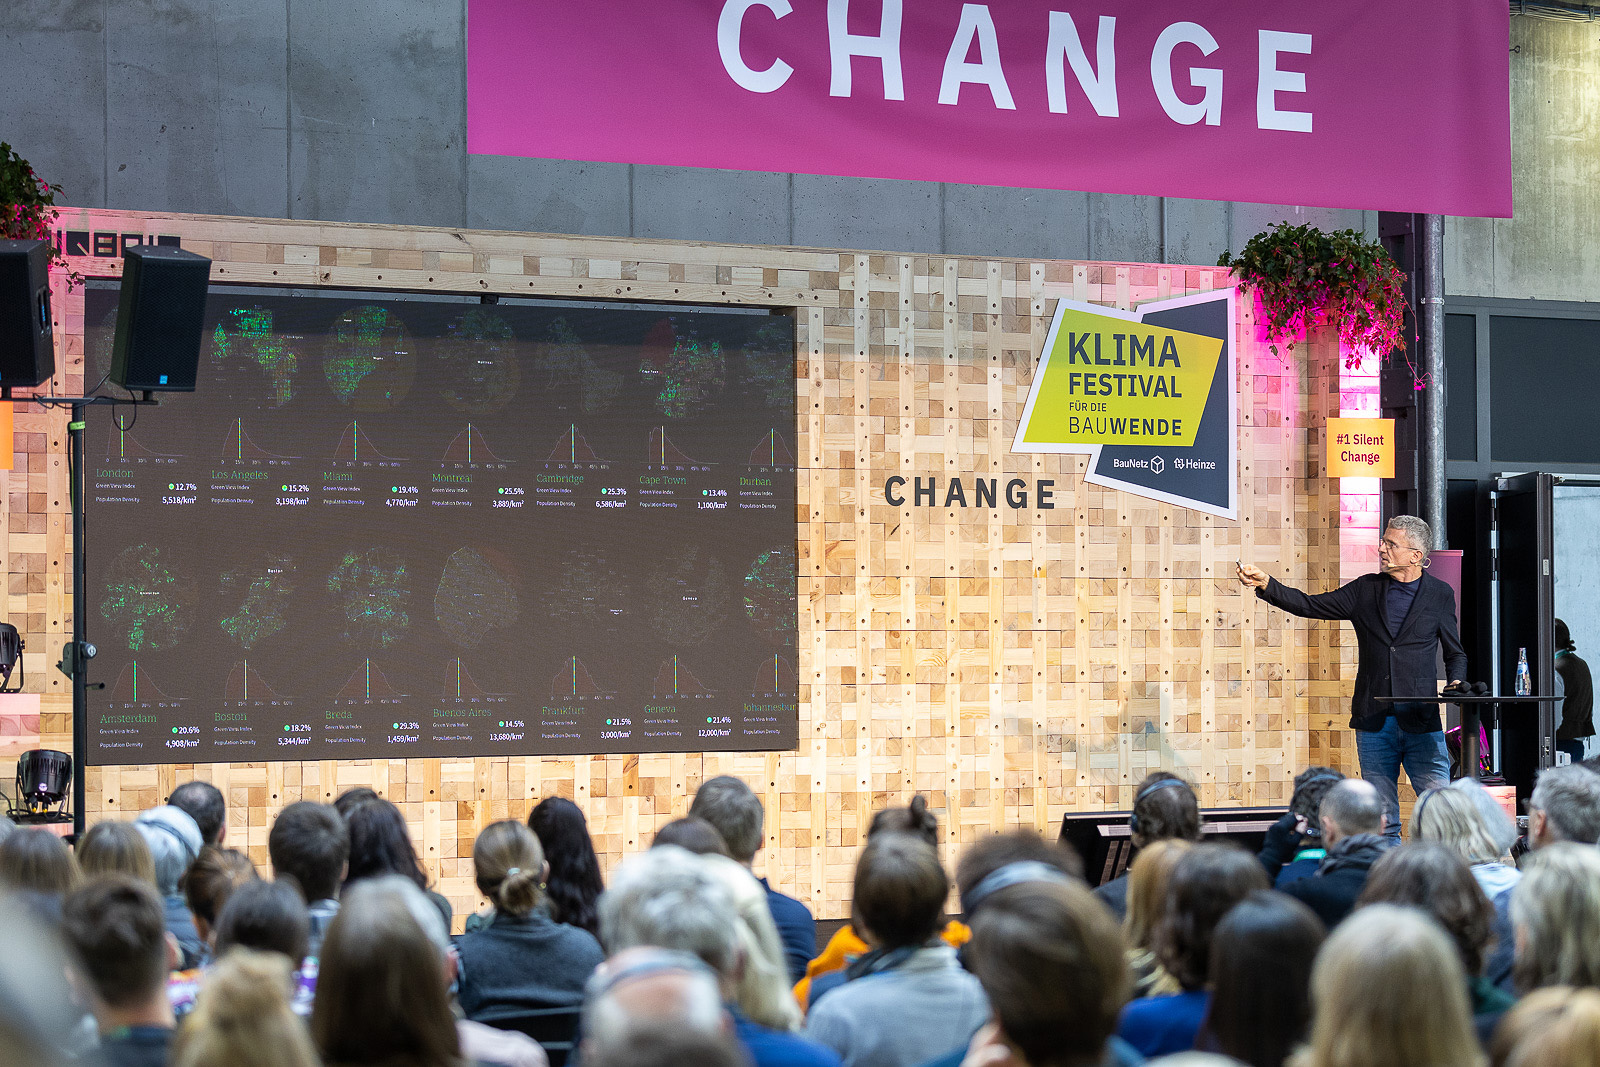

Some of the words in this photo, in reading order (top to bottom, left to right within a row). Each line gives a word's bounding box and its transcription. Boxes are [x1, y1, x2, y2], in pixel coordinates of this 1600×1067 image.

[717, 0, 1312, 133] CHANGE
[1069, 332, 1181, 367] KLIMA
[1069, 372, 1182, 398] FESTIVAL
[1069, 400, 1088, 412] FÜR
[1090, 402, 1107, 412] DIE
[1069, 416, 1182, 436] BAUWENDE
[1336, 434, 1350, 445] #1
[1353, 434, 1384, 445] Silent
[1113, 458, 1148, 468] BauNetz
[1341, 451, 1380, 465] Change
[1186, 458, 1216, 469] Heinze
[97, 468, 134, 477] London
[212, 470, 228, 479] Los
[231, 471, 268, 481] Angeles
[324, 472, 353, 480] Miami
[433, 474, 473, 482] Montreal
[537, 474, 584, 485] Cambridge
[640, 476, 660, 486] Cape
[663, 476, 686, 484] Town
[740, 477, 771, 485] Durban
[885, 475, 1055, 509] CHANGE
[434, 708, 465, 717] Buenos
[469, 708, 491, 717] Aires
[543, 706, 585, 714] Frankfurt
[644, 705, 675, 713] Geneva
[100, 714, 156, 723] Amsterdam
[215, 713, 247, 721] Boston
[326, 711, 352, 719] Breda
[291, 724, 311, 732] 18.2%
